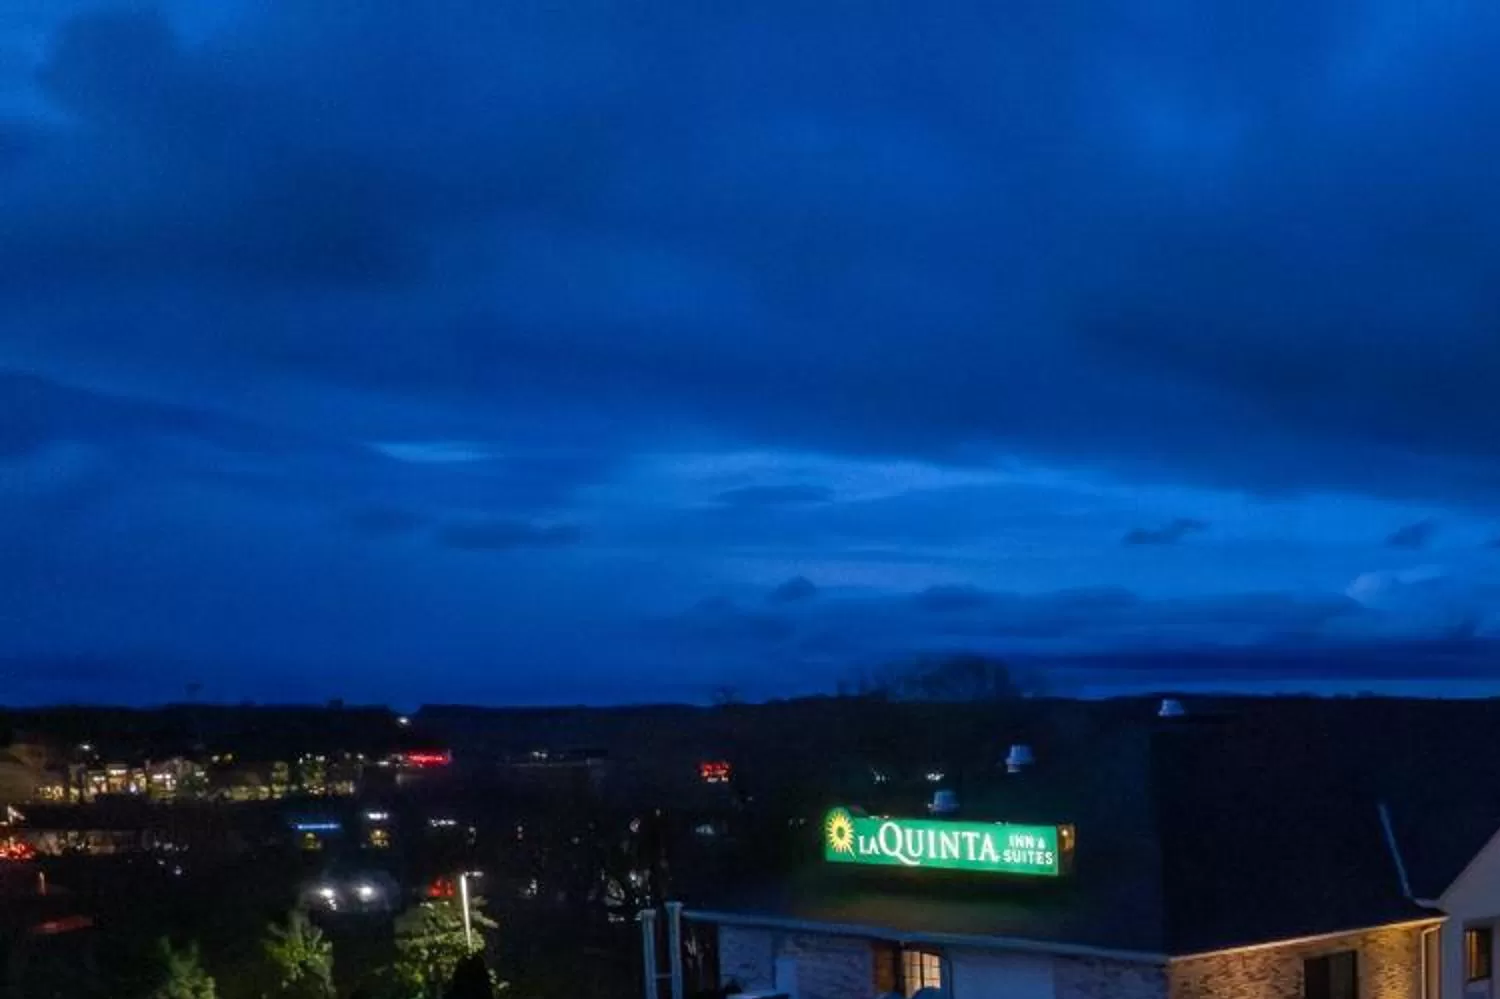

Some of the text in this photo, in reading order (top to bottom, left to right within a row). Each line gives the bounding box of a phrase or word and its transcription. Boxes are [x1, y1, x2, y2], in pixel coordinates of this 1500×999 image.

[858, 822, 998, 866] LA QUINTA
[1008, 834, 1034, 849] INN
[1003, 849, 1053, 865] SUITES
